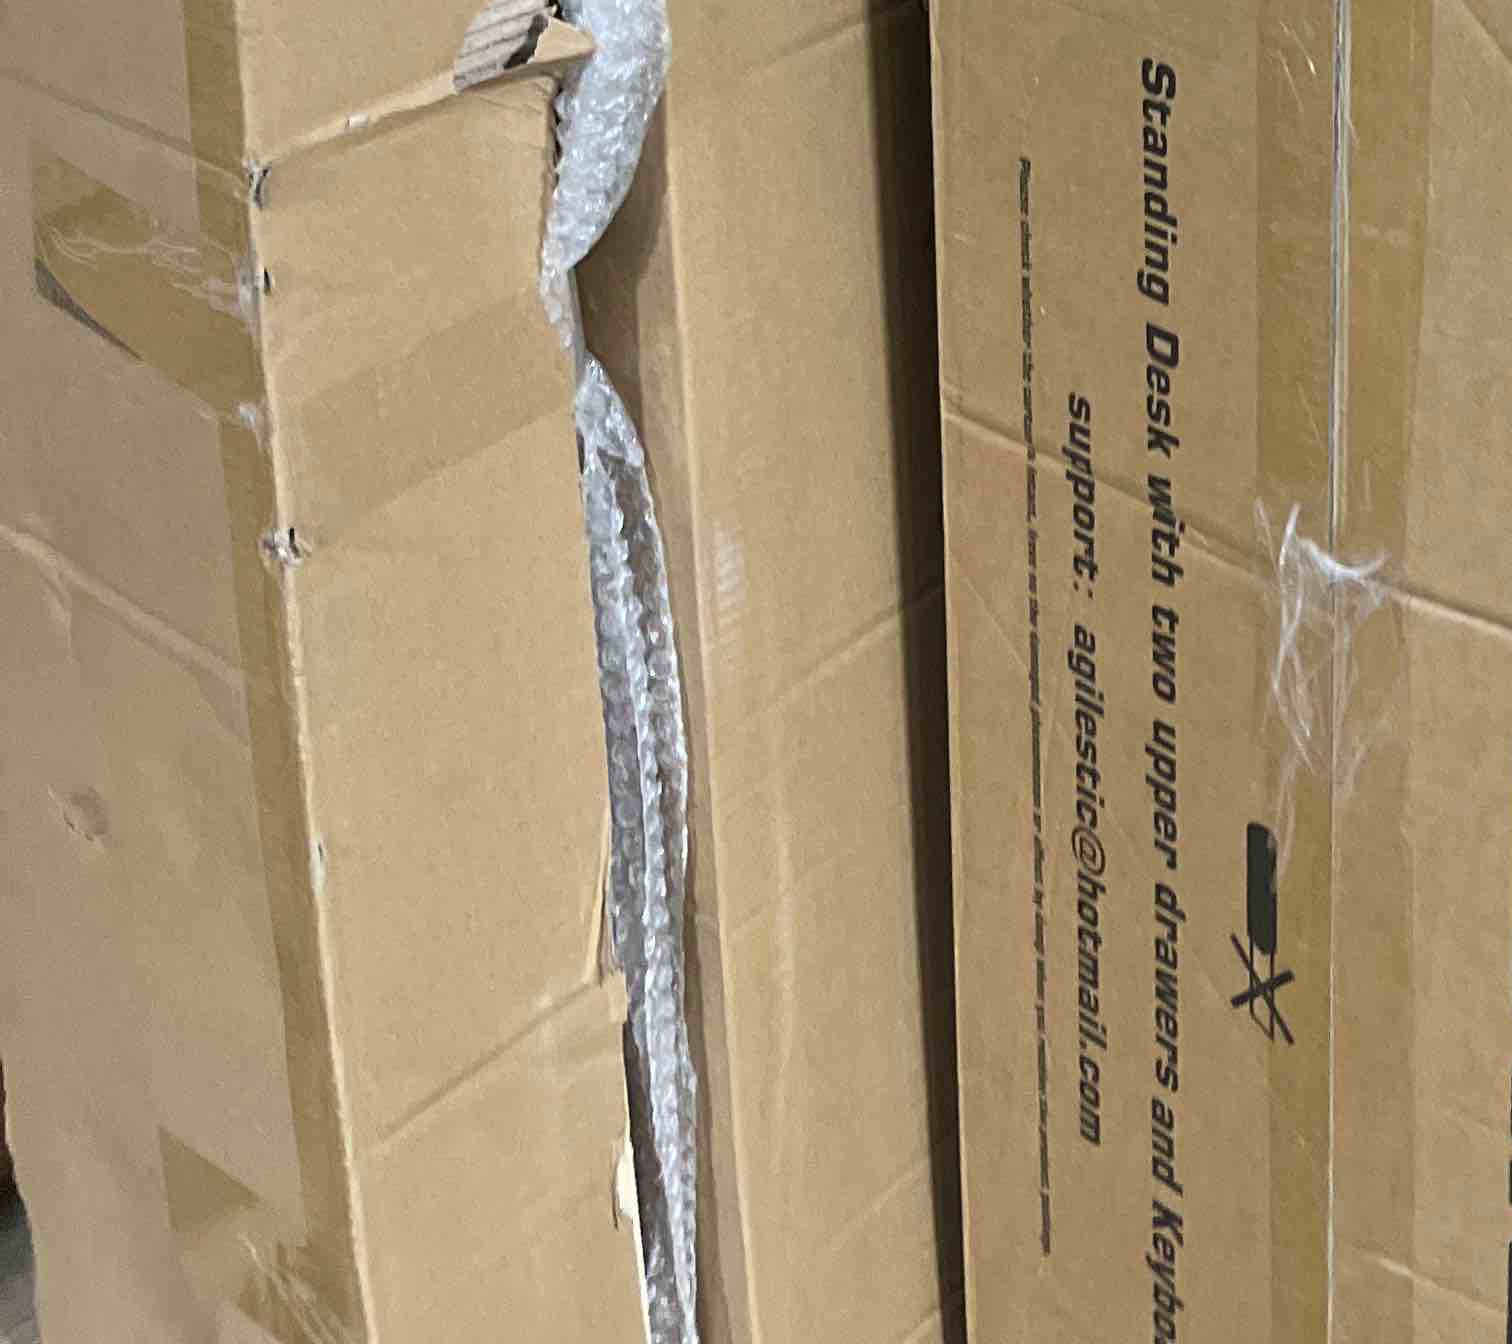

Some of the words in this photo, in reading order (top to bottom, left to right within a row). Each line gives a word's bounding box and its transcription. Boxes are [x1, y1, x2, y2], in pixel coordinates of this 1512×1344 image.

[1133, 56, 1180, 307] Standing
[1145, 321, 1181, 460] Desk
[1060, 391, 1099, 600] support:
[1146, 472, 1184, 587] with
[1149, 603, 1181, 705] two
[1145, 719, 1179, 870] upper
[1066, 624, 1108, 1147] agilestic@hotmail.com
[1153, 883, 1184, 1092] drawers
[1152, 1097, 1182, 1198] and
[1145, 1198, 1185, 1344] Keybo
